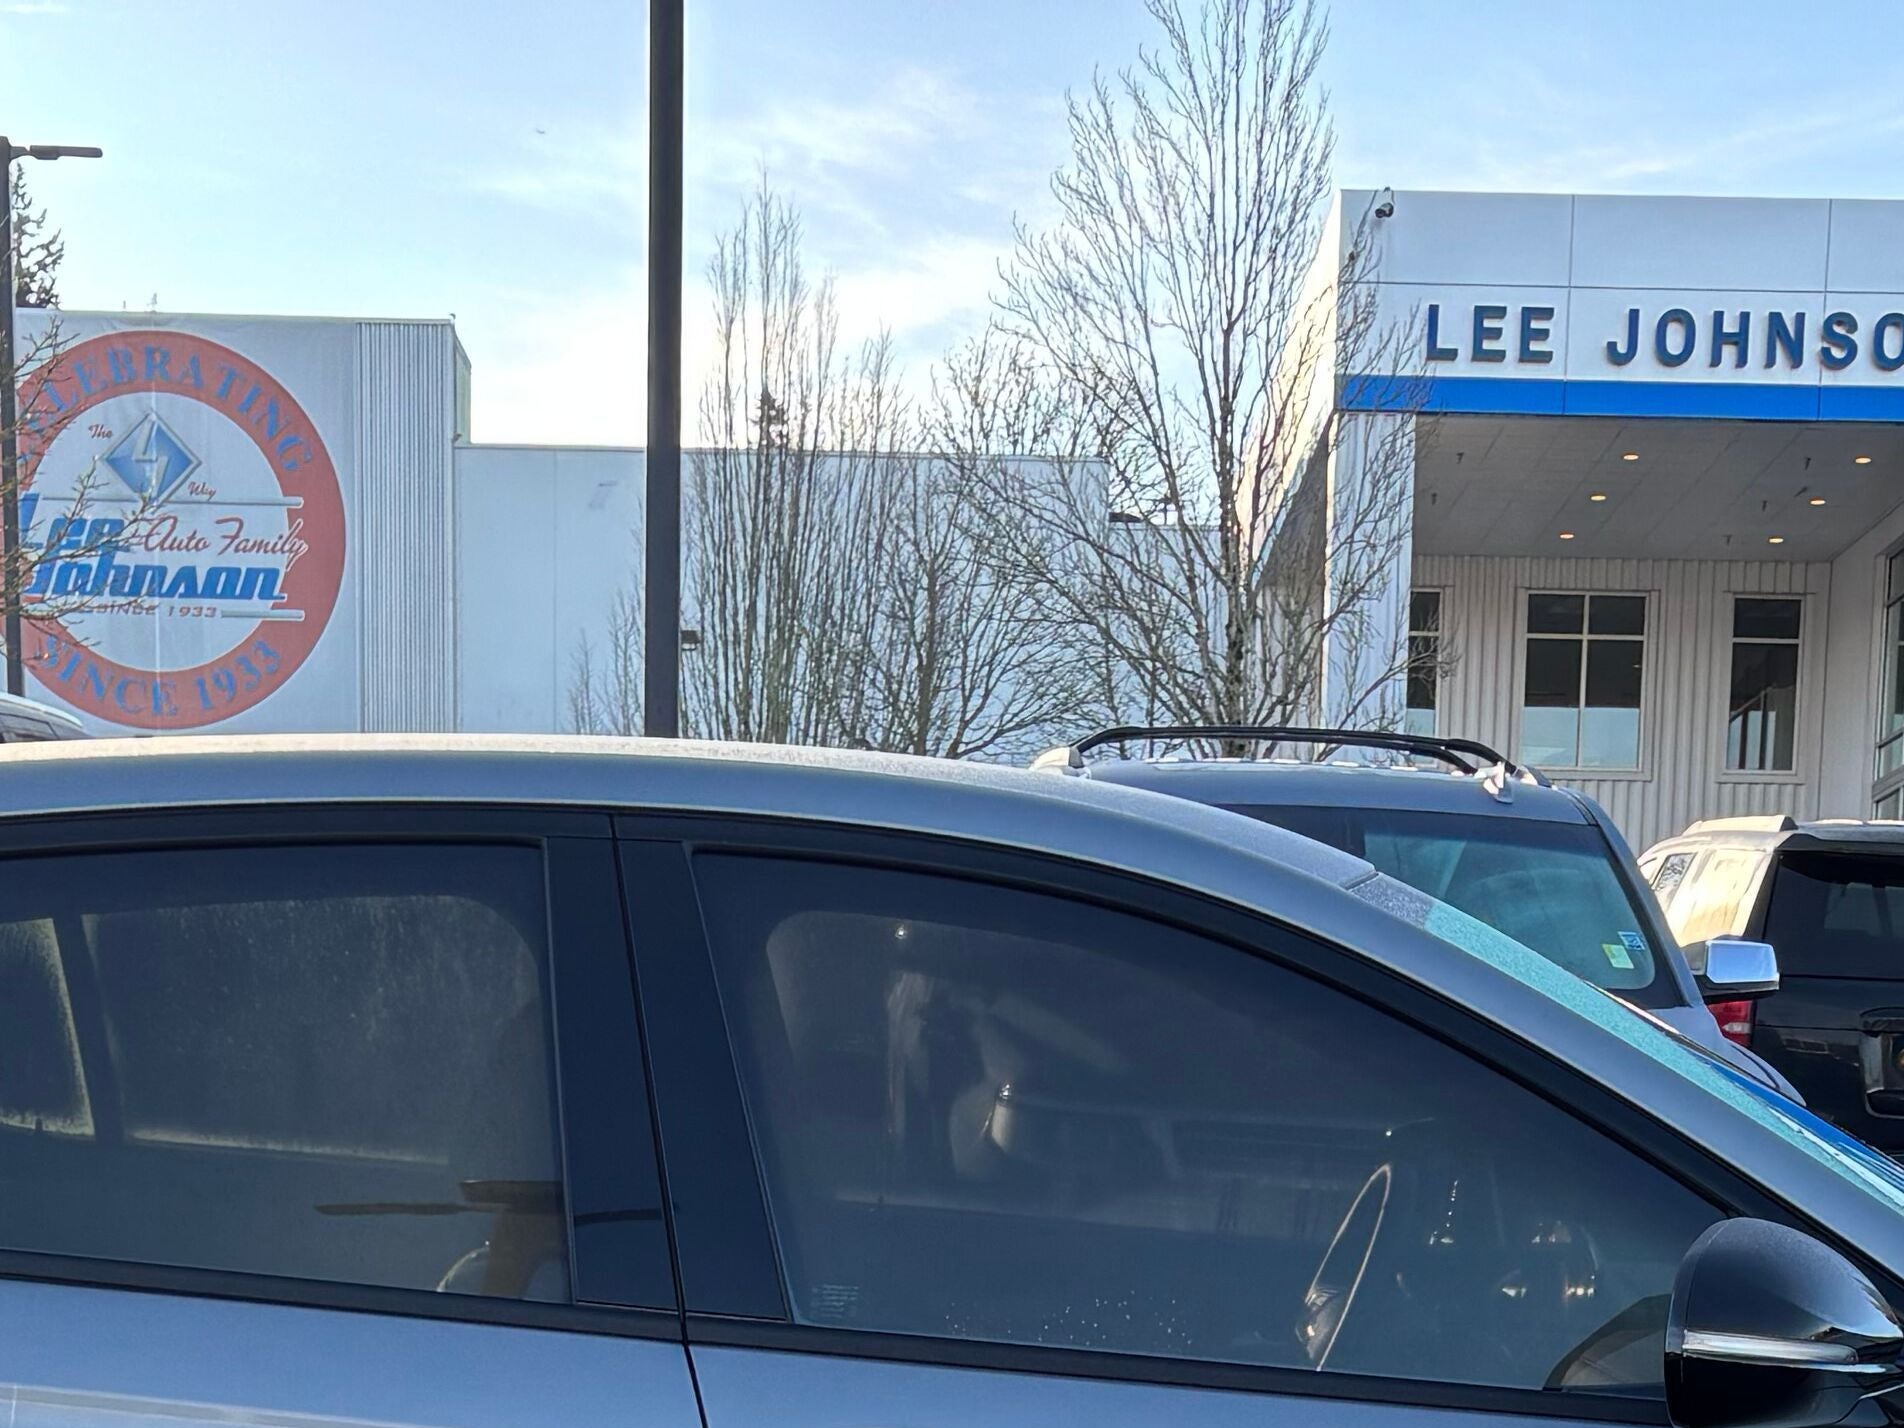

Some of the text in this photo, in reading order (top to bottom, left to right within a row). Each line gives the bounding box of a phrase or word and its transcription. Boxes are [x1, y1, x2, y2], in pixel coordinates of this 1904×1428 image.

[1426, 304, 1555, 363] LEE
[88, 424, 114, 440] The
[18, 491, 309, 573] Lee Auto Family
[20, 550, 287, 600] Johnson
[167, 605, 217, 618] 1933
[36, 634, 282, 717] SINCE 1933
